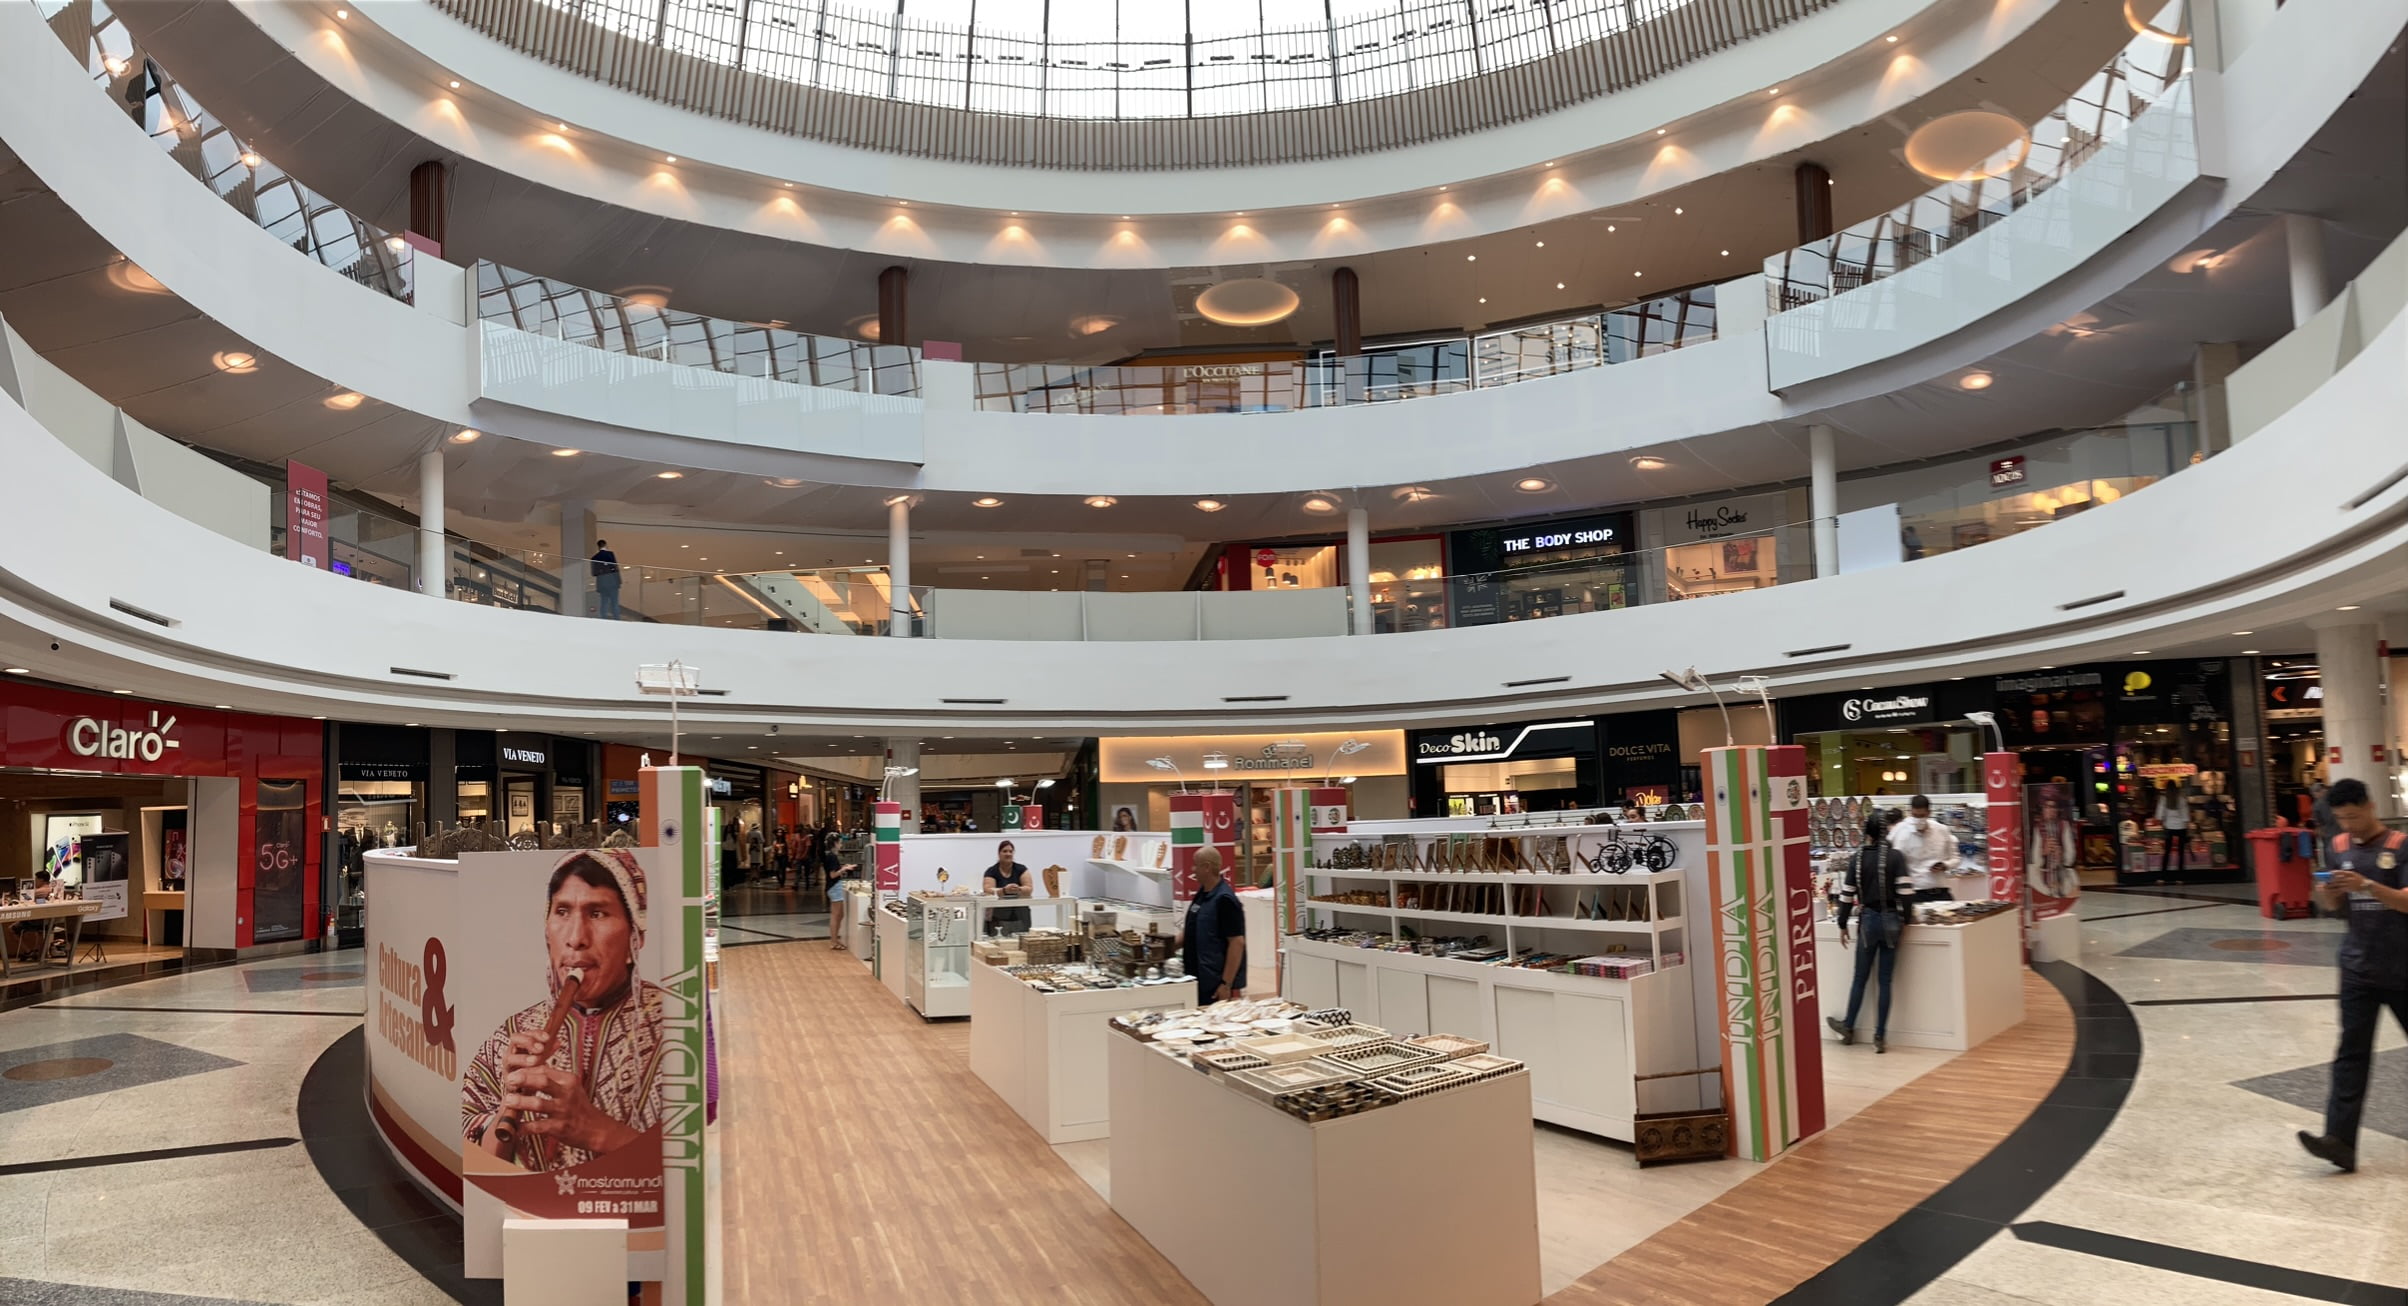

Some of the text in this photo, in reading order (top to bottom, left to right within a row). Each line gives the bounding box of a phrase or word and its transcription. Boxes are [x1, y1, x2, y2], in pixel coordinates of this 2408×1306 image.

[310, 512, 321, 520] SEU
[1686, 506, 1748, 532] Happy Socks
[1504, 529, 1613, 552] THE BODY SHOP
[71, 717, 164, 762] Claro
[1451, 731, 1500, 754] Skin
[1609, 743, 1672, 757] DOLCE VITA
[503, 748, 545, 763] VIA VENETO
[1234, 755, 1313, 770] Rommanel
[361, 769, 408, 778] VIA VENETO
[260, 843, 298, 870] 5G+
[77, 904, 99, 913] Galaxy
[1790, 887, 1816, 1003] PERU
[379, 936, 455, 1055] Cultura &
[379, 989, 457, 1082] Artesanato
[578, 1200, 659, 1214] 09 FEV a 31 MAR
